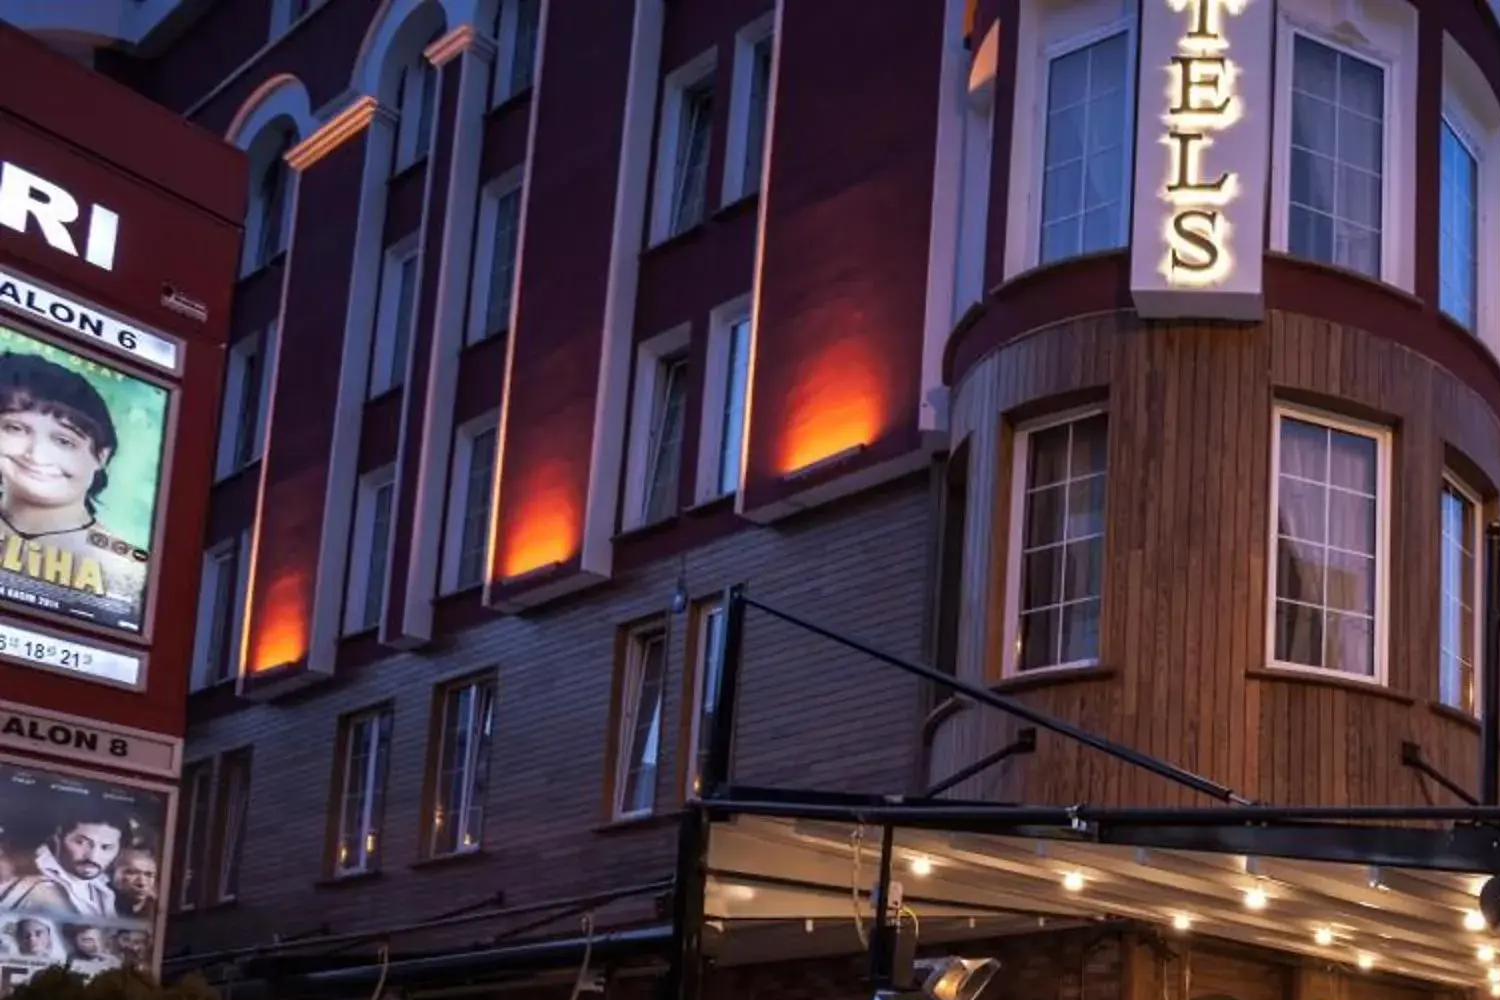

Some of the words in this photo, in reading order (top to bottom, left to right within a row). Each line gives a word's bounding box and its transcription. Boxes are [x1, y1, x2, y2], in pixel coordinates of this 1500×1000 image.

[117, 329, 138, 350] 6
[2, 716, 98, 752] ALON
[109, 738, 129, 758] 8
